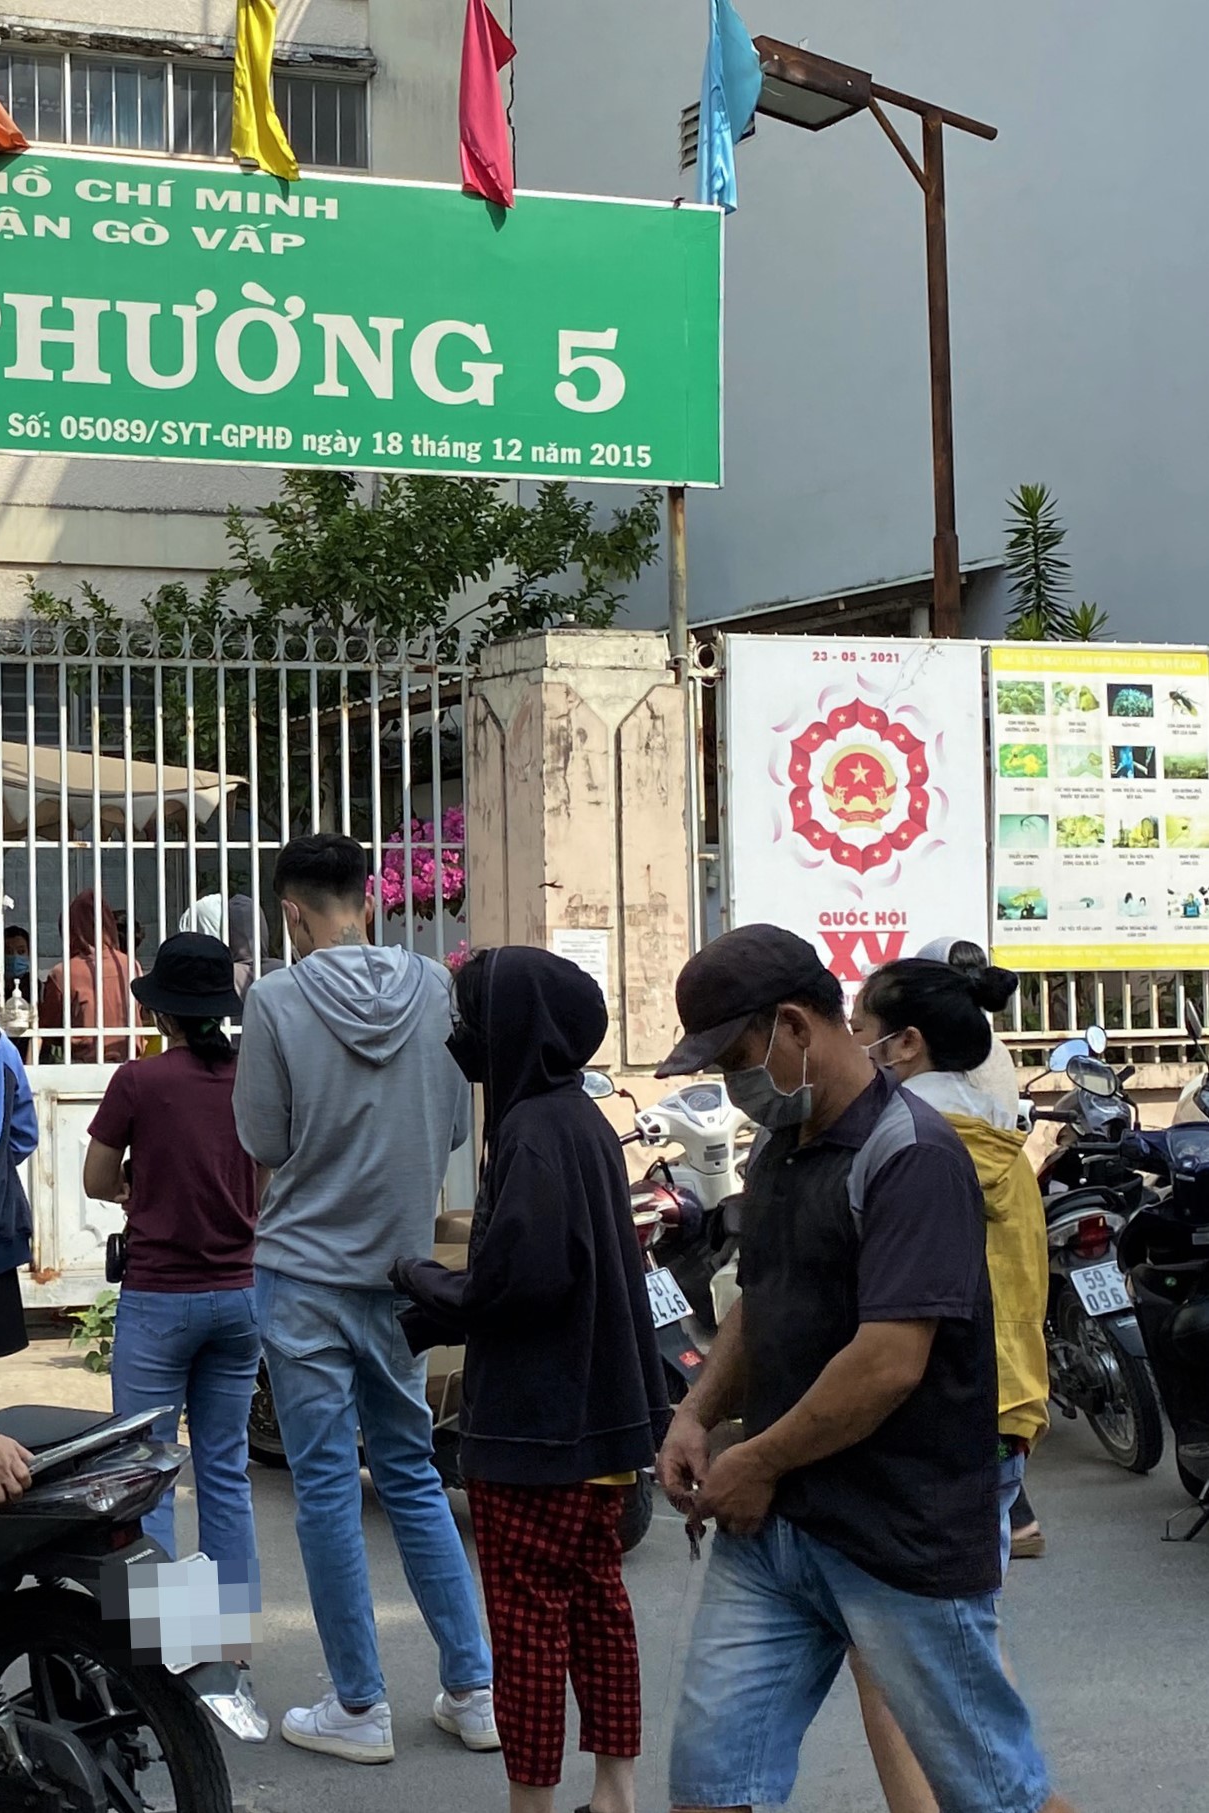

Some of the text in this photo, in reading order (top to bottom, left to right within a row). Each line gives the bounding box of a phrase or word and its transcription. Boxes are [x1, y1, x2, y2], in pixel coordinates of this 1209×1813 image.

[74, 177, 172, 207] CHÍ
[195, 187, 339, 220] MINH
[92, 217, 170, 247] GÒ
[192, 222, 306, 255] VẤP
[554, 327, 626, 413] 5
[7, 408, 51, 439] Số:
[59, 414, 293, 451] 05089/SYT-GPHĐ
[302, 431, 361, 456] ngày
[372, 432, 403, 455] 18
[411, 434, 482, 463] tháng
[492, 438, 523, 462] 12
[530, 440, 581, 465] năm
[589, 443, 651, 468] 2015
[812, 651, 828, 661] 23
[841, 652, 857, 662] 05
[870, 652, 900, 663] 2021
[819, 907, 907, 929] QUỐC HỘI
